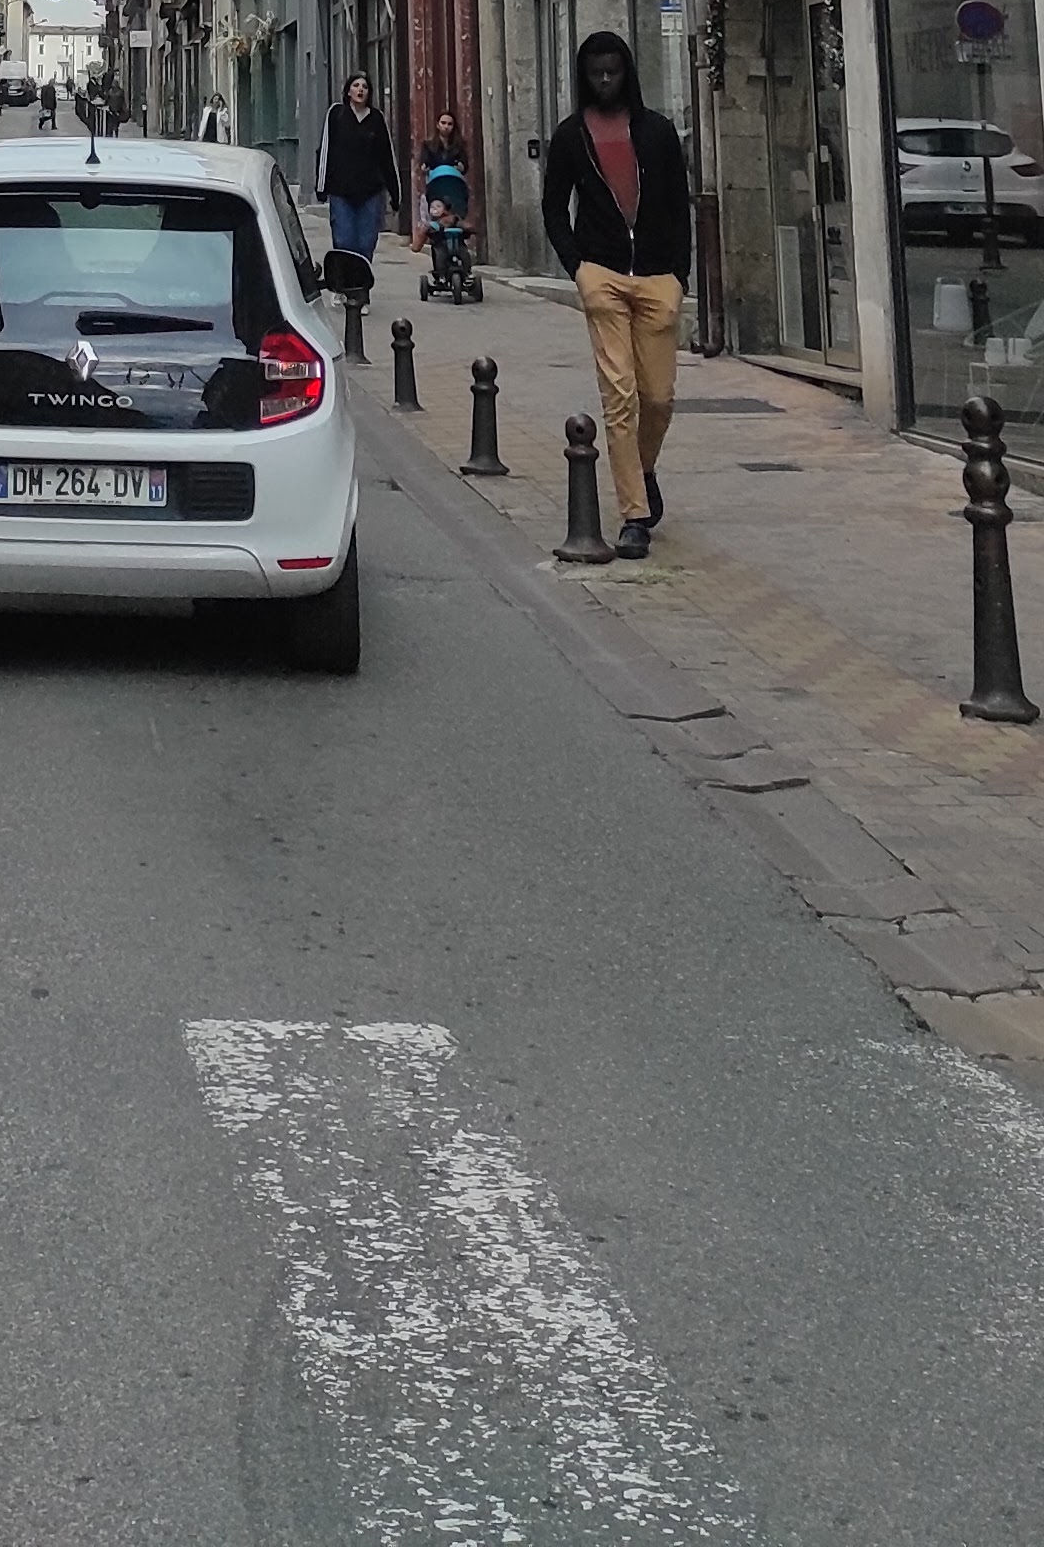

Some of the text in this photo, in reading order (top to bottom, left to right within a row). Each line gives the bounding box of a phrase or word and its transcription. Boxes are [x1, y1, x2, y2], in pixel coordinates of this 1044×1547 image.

[27, 392, 134, 408] TWINGO
[12, 466, 144, 499] DM-264-DV
[150, 485, 163, 499] 11
